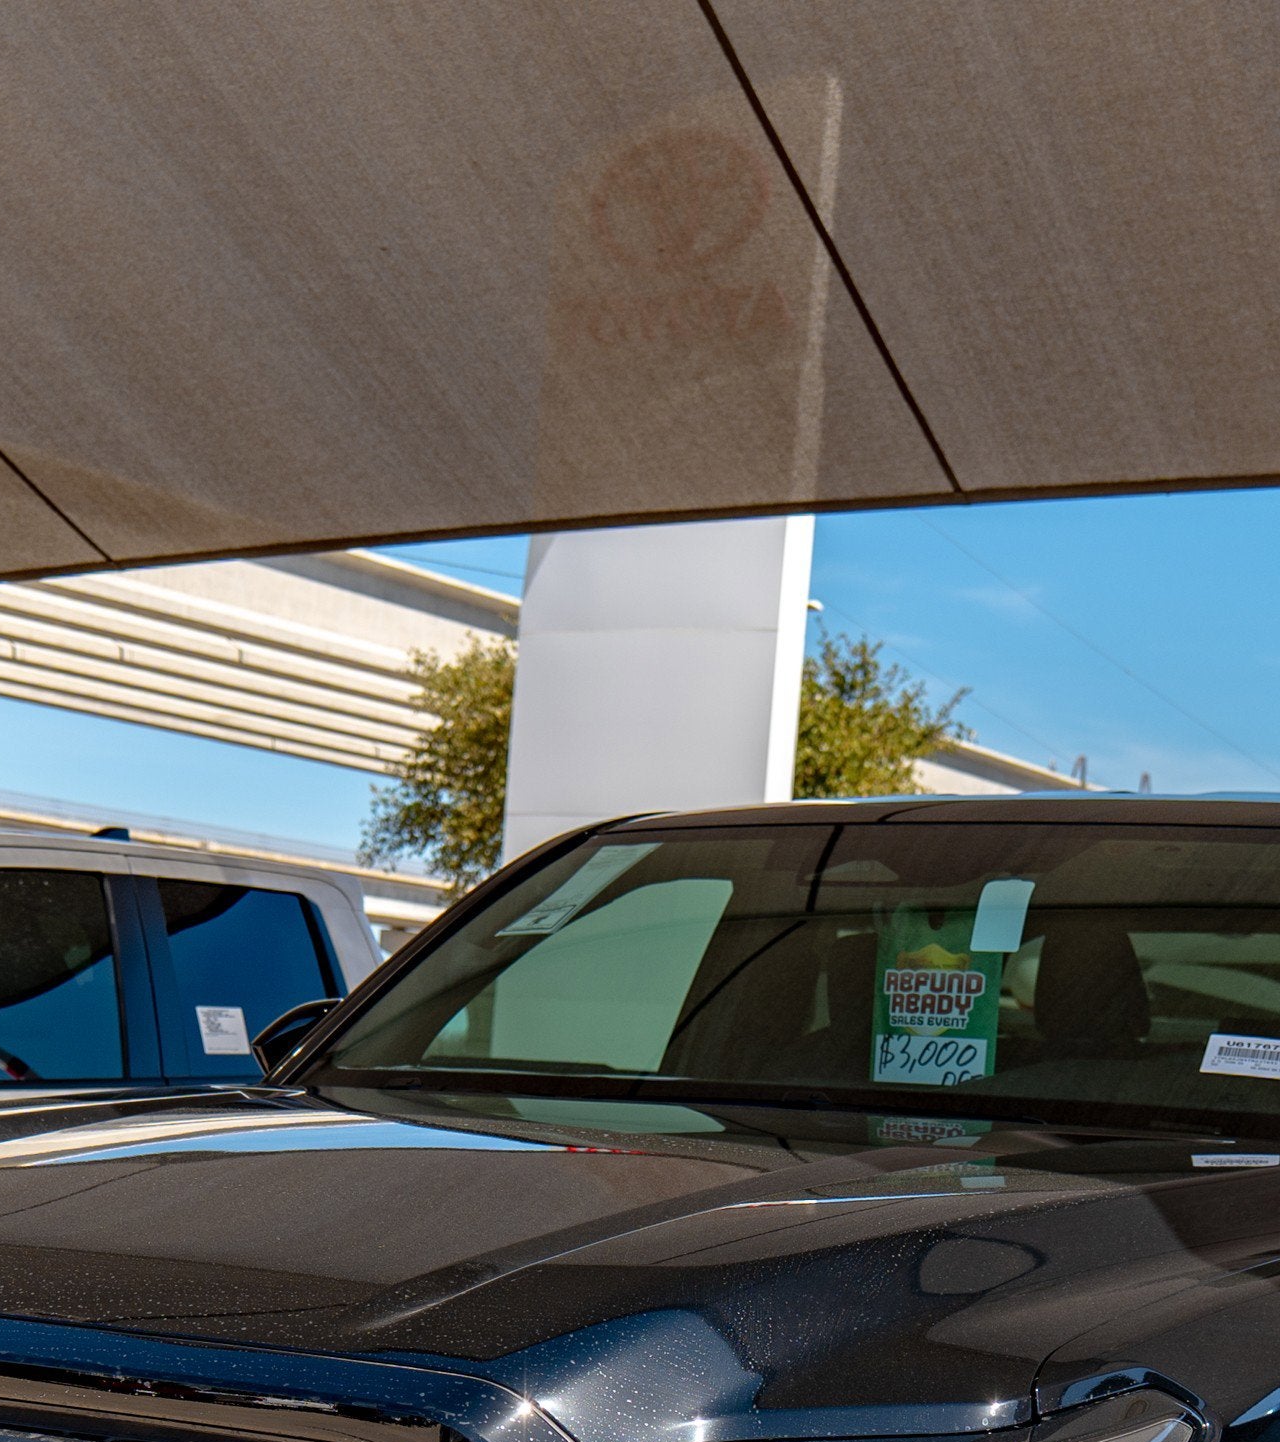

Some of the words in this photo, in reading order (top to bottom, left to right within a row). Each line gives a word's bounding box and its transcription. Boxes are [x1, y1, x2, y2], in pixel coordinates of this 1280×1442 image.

[886, 972, 983, 993] REFUND
[892, 994, 972, 1014] READY
[890, 1015, 924, 1026] SALES
[928, 1017, 968, 1027] EVENT
[879, 1033, 977, 1074] $3,000
